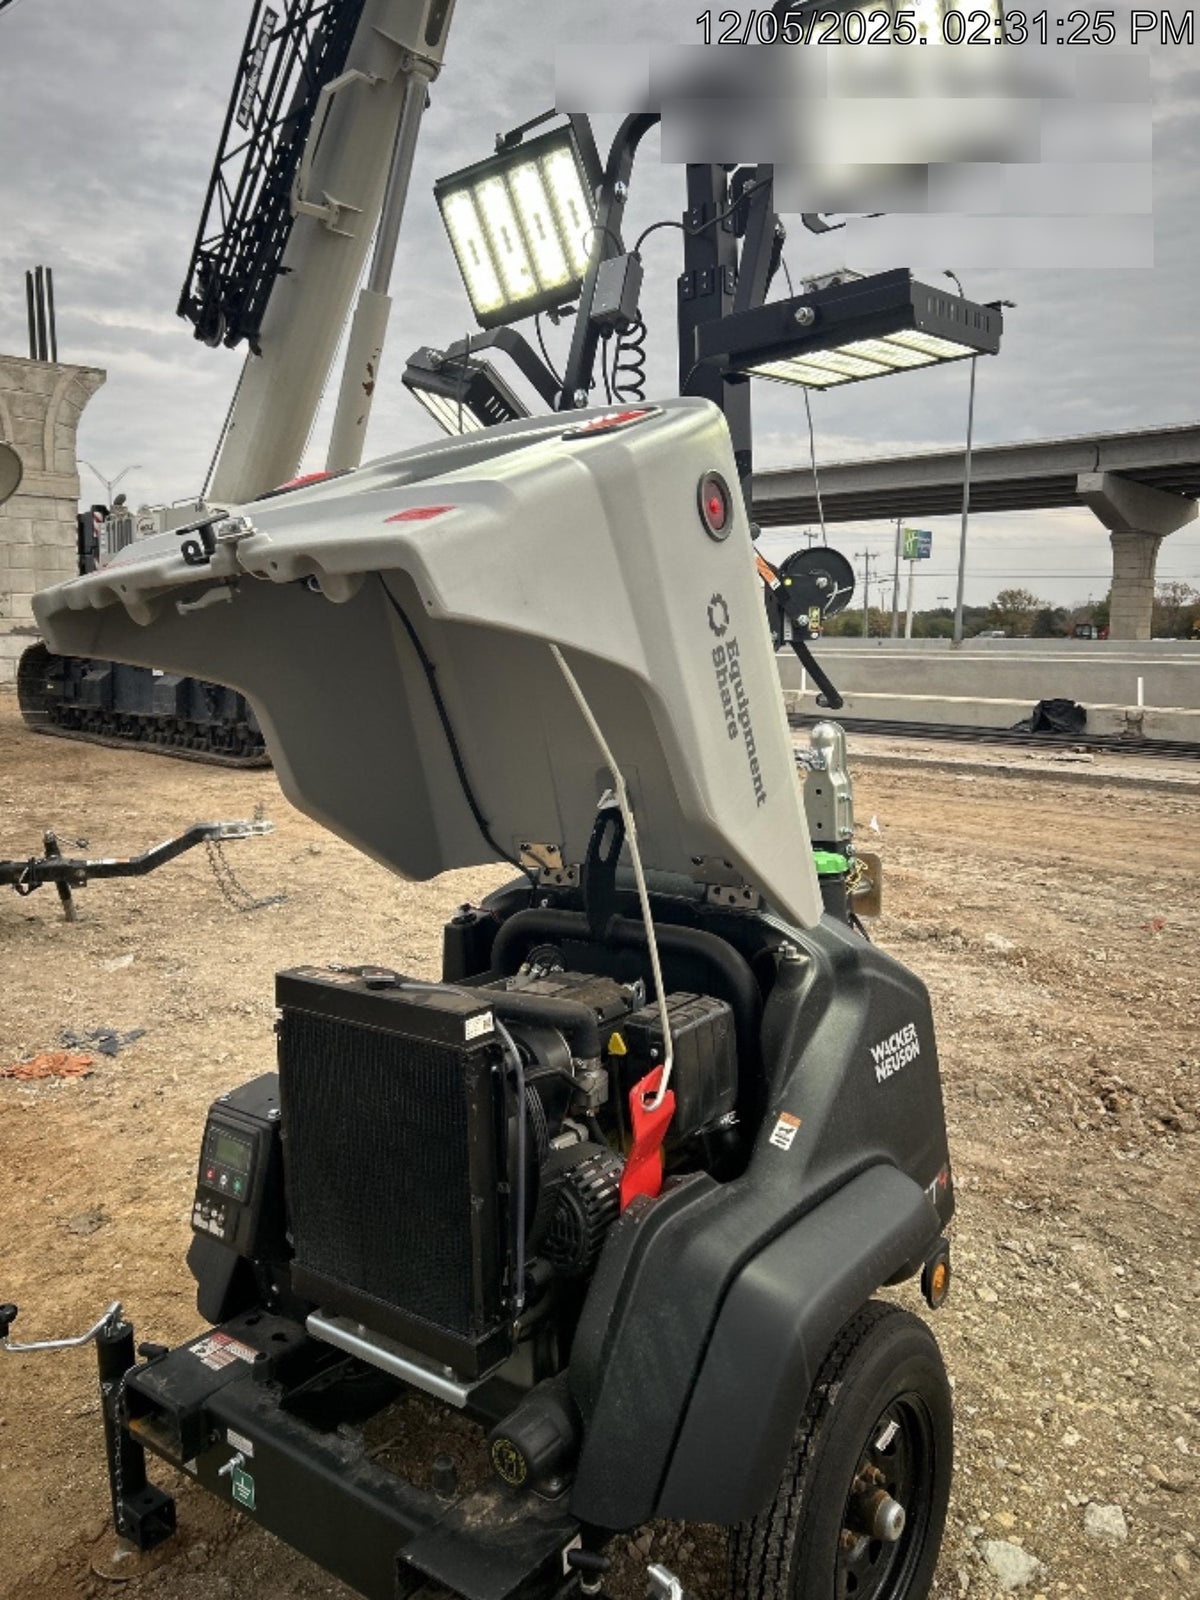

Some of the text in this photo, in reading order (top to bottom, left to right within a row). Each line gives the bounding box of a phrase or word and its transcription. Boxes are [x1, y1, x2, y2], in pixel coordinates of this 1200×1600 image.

[712, 644, 739, 741] Share
[726, 635, 768, 808] Equipment
[869, 1022, 918, 1064] WACKER
[874, 1037, 921, 1084] NEUSON
